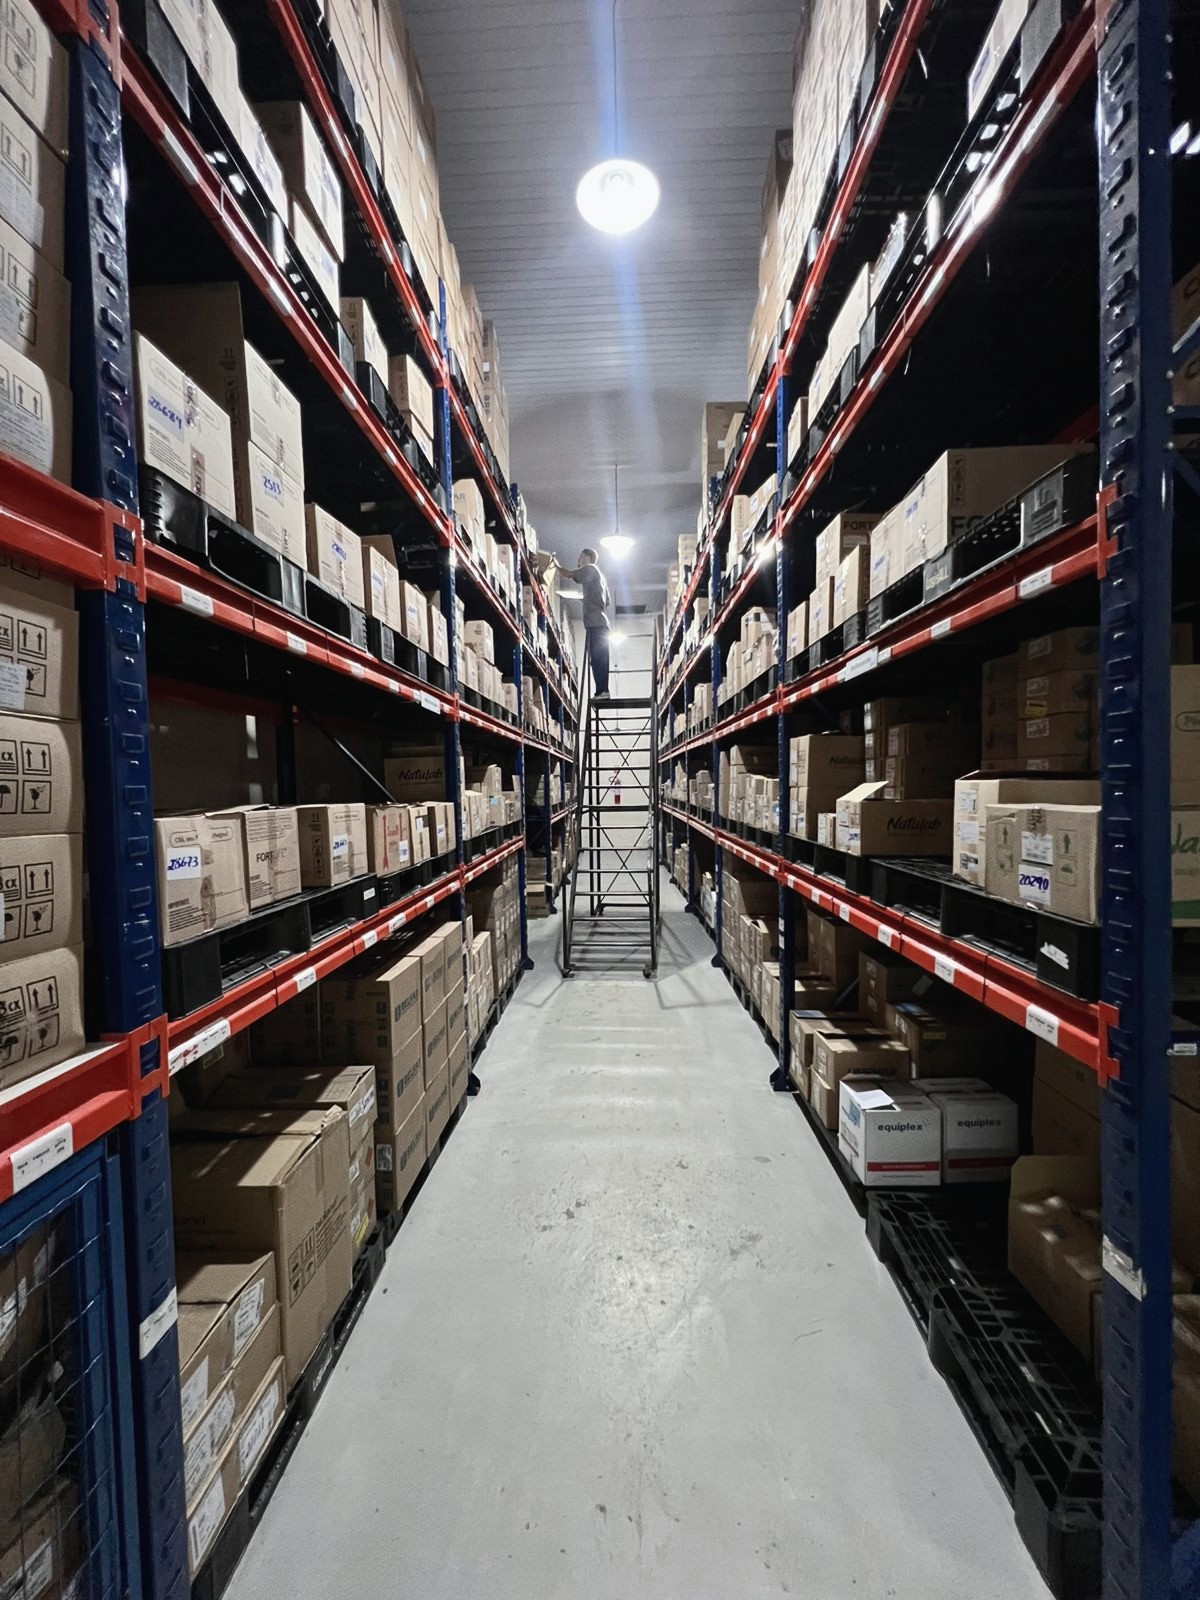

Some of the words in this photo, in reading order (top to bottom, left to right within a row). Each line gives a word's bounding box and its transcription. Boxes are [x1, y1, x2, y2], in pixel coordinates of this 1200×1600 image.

[399, 768, 443, 781] Natulab
[886, 817, 942, 832] Natulab
[1019, 873, 1050, 891] 20290
[877, 1122, 923, 1133] equiplex
[957, 1117, 1001, 1128] equiplex
